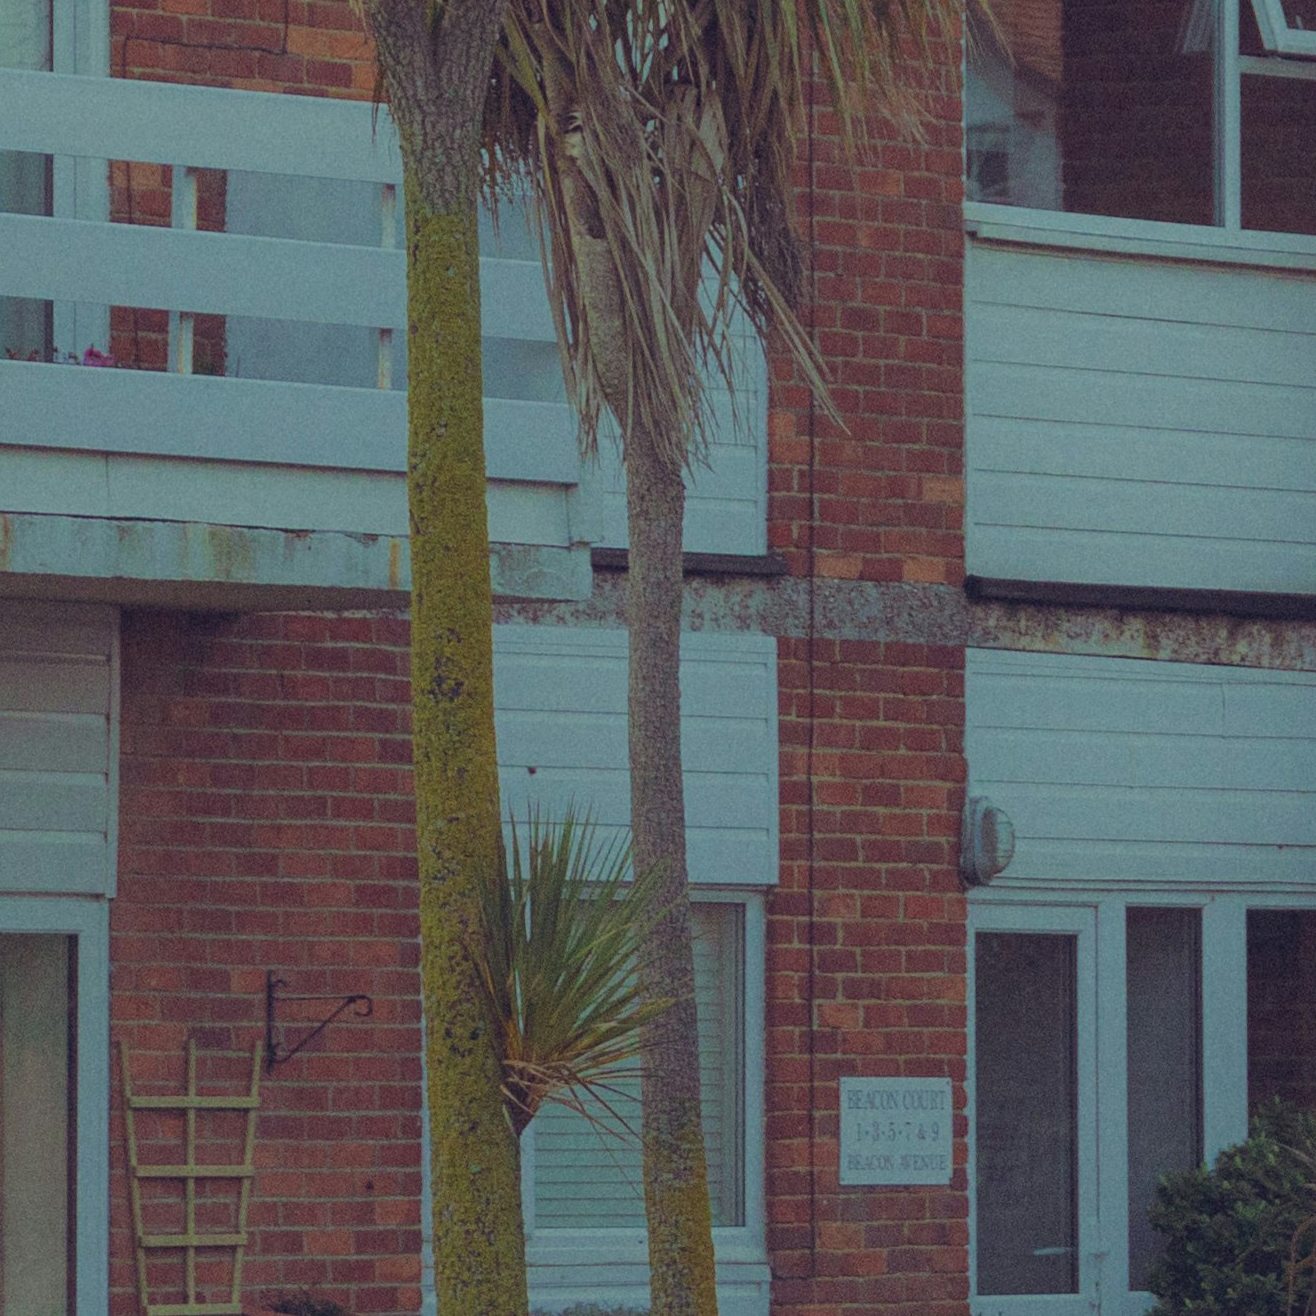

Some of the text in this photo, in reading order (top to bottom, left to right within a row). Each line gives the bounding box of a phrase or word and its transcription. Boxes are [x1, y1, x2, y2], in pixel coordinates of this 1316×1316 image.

[847, 1089, 946, 1110] BEACON COURT
[931, 1121, 940, 1142] 9
[847, 1153, 947, 1171] BEACON AVENUE
